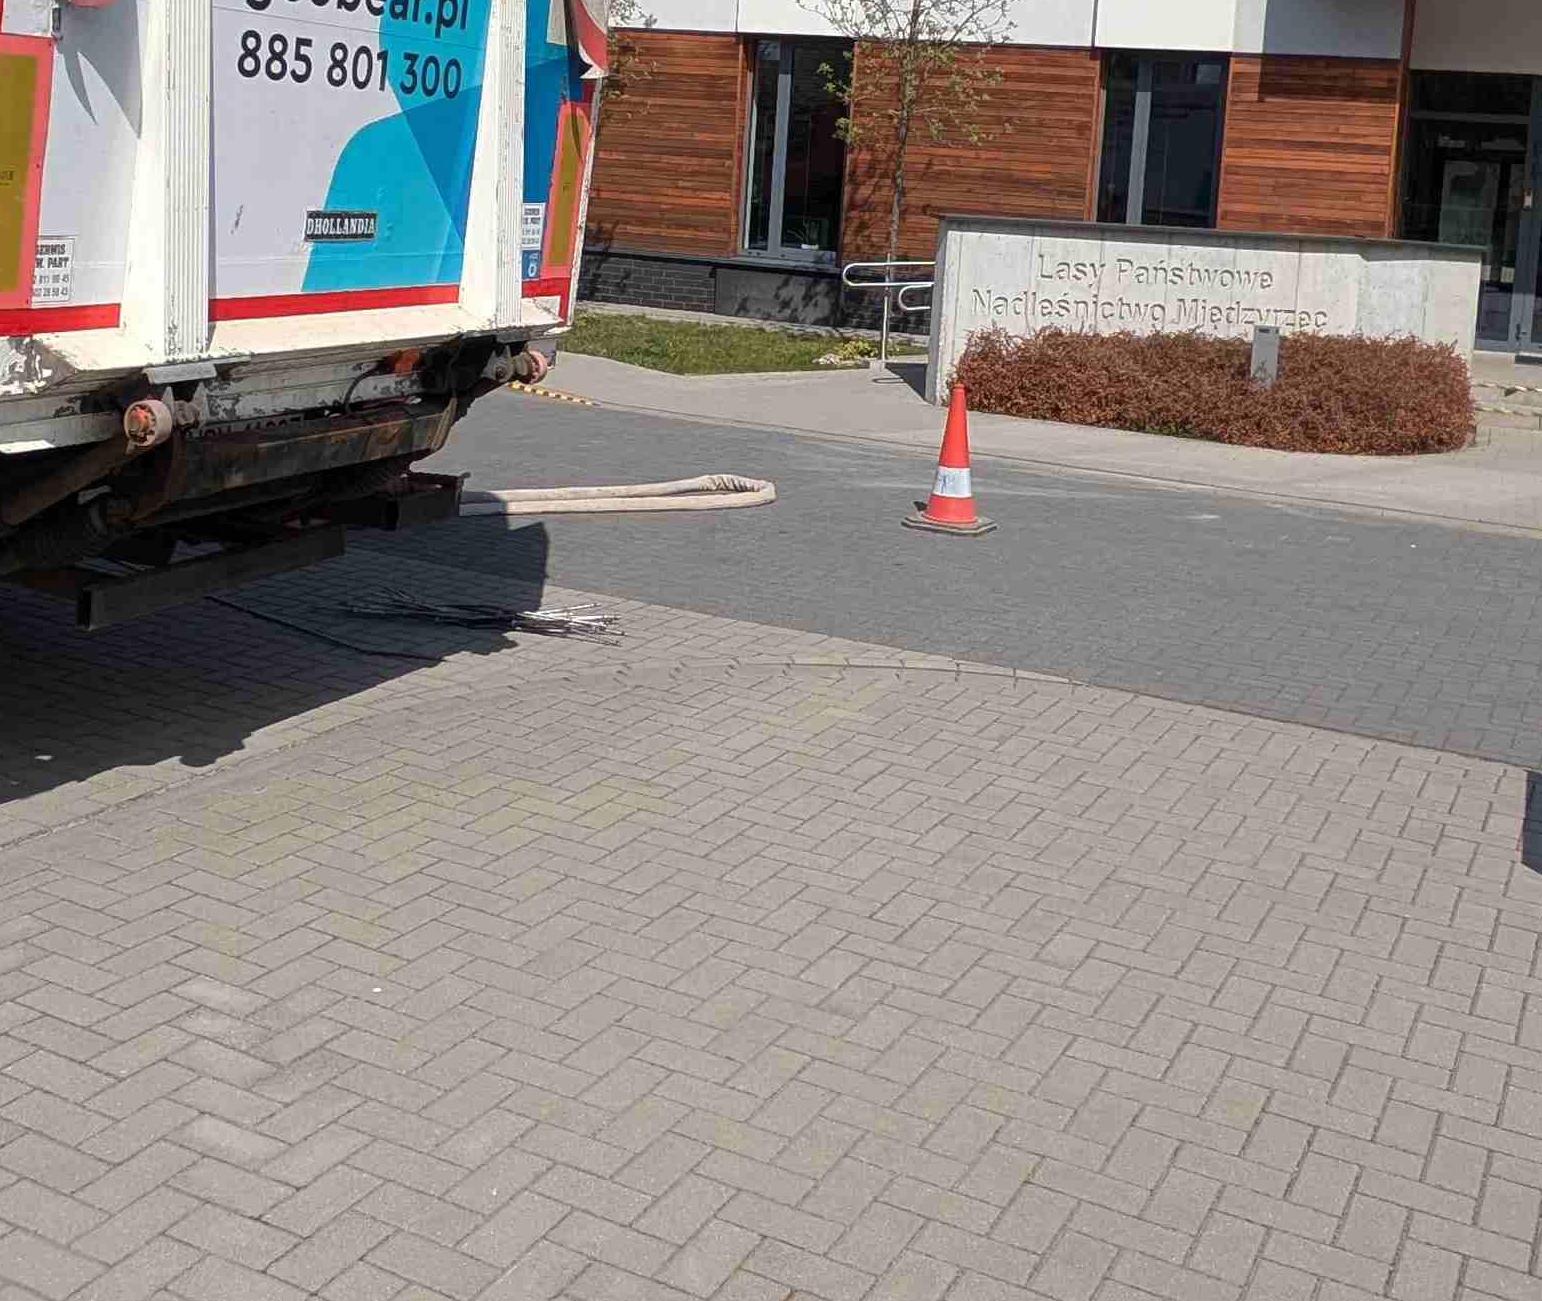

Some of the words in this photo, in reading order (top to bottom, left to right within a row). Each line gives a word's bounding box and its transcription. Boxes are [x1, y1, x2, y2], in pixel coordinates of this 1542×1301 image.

[237, 30, 313, 83] 885
[327, 42, 388, 91] 801
[399, 52, 461, 99] 300
[306, 218, 375, 235] DHOLLANDIA
[1037, 254, 1107, 288] Lasy
[1115, 258, 1274, 290] Państwowe
[971, 289, 1168, 324] Nadleśnictwo
